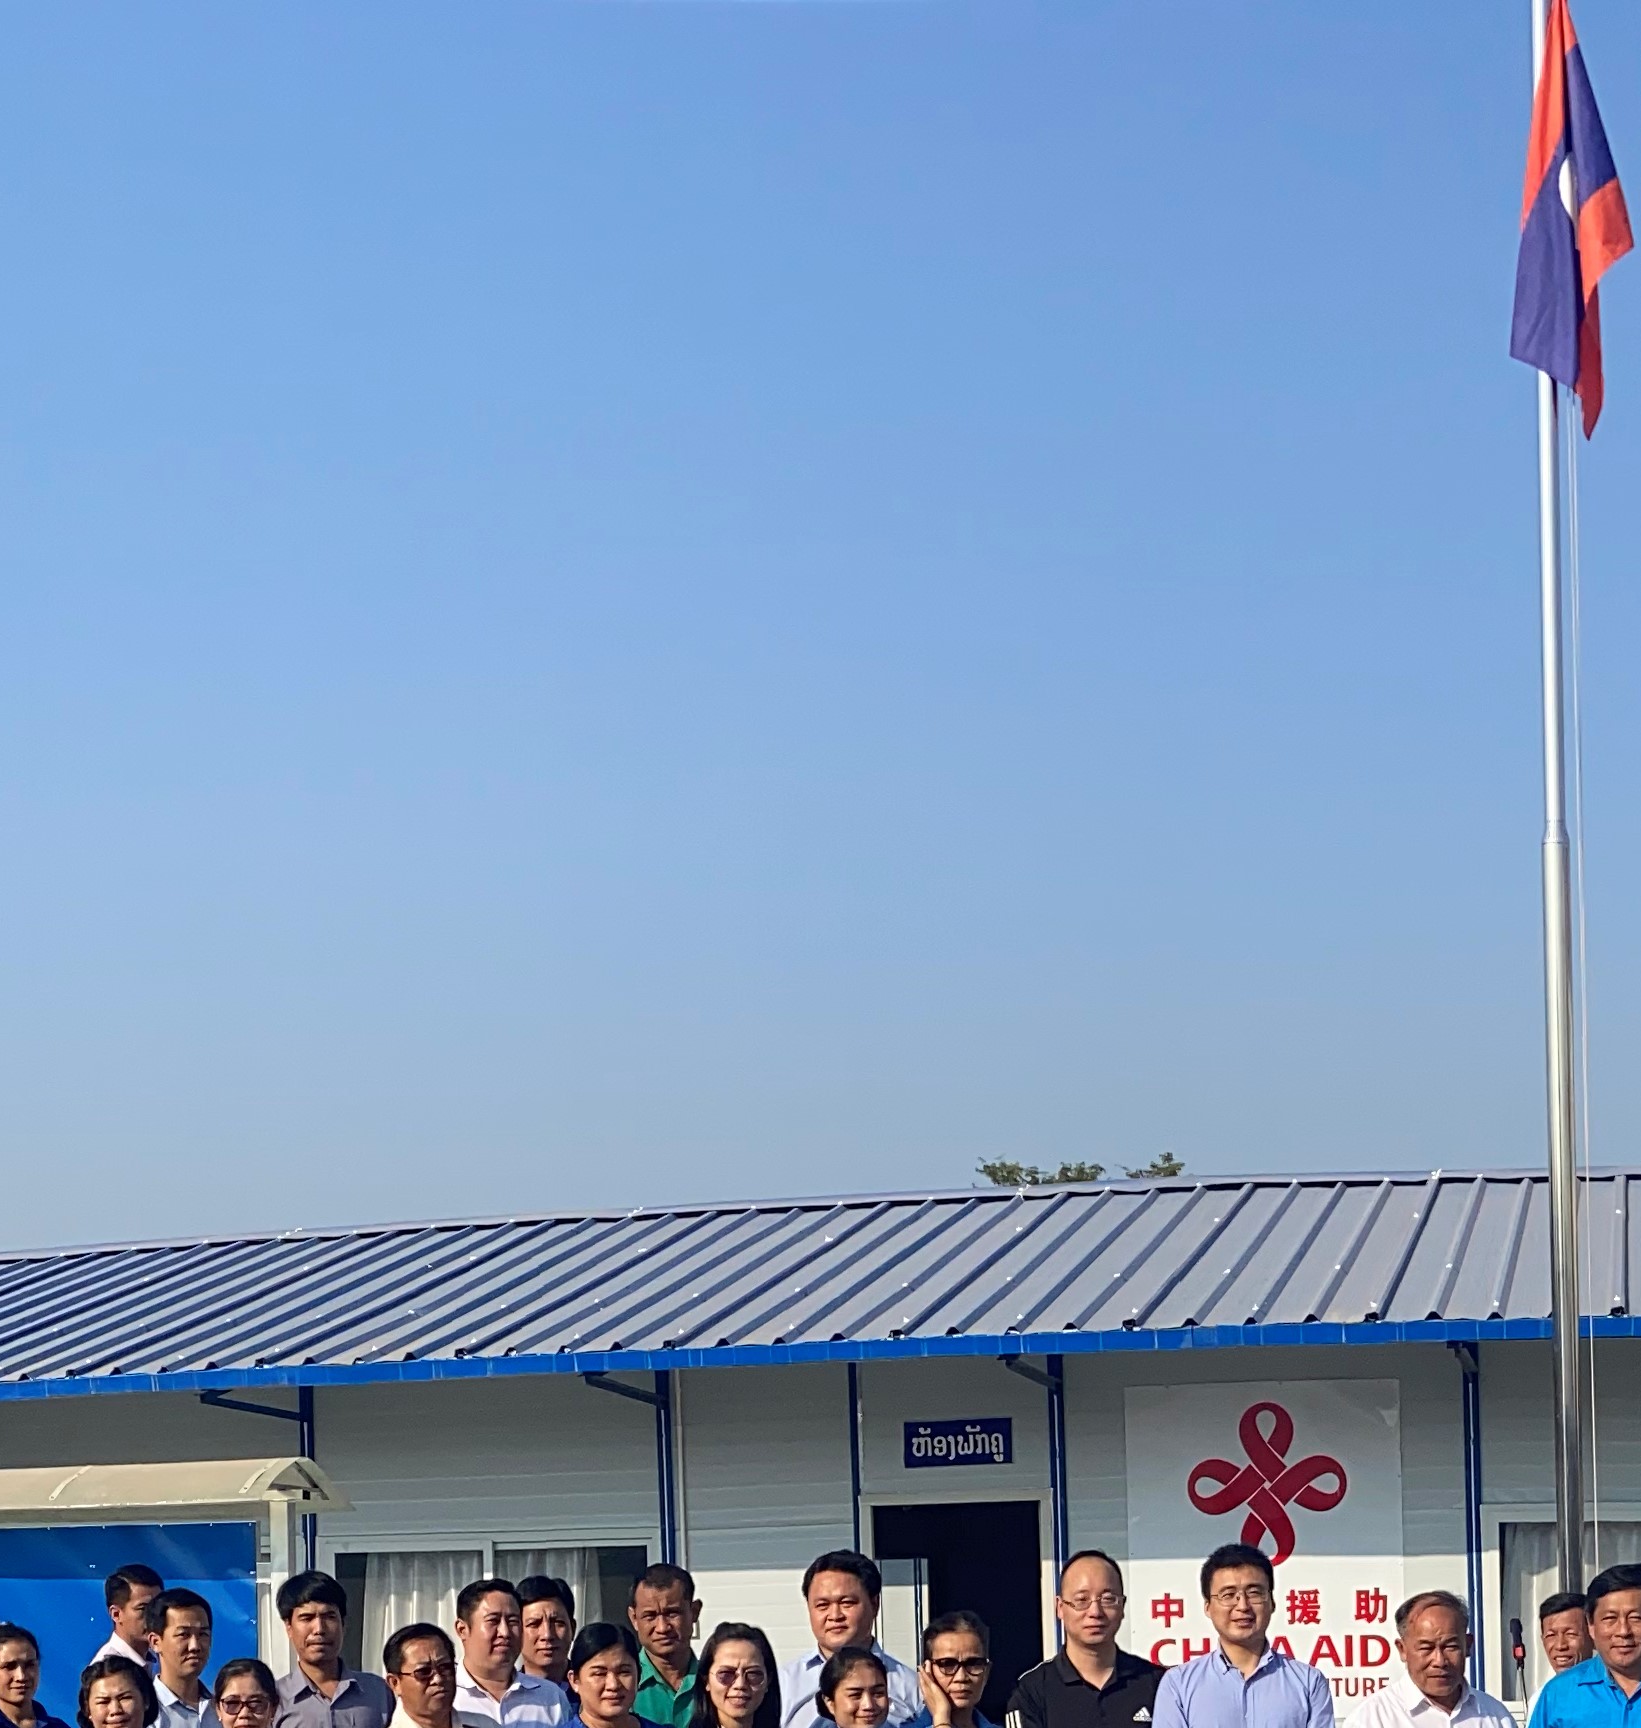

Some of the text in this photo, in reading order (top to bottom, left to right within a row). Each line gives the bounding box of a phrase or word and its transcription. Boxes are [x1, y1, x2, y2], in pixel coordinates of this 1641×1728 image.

[1151, 1587, 1388, 1628] 中援助
[1150, 1634, 1391, 1668] CHA AID
